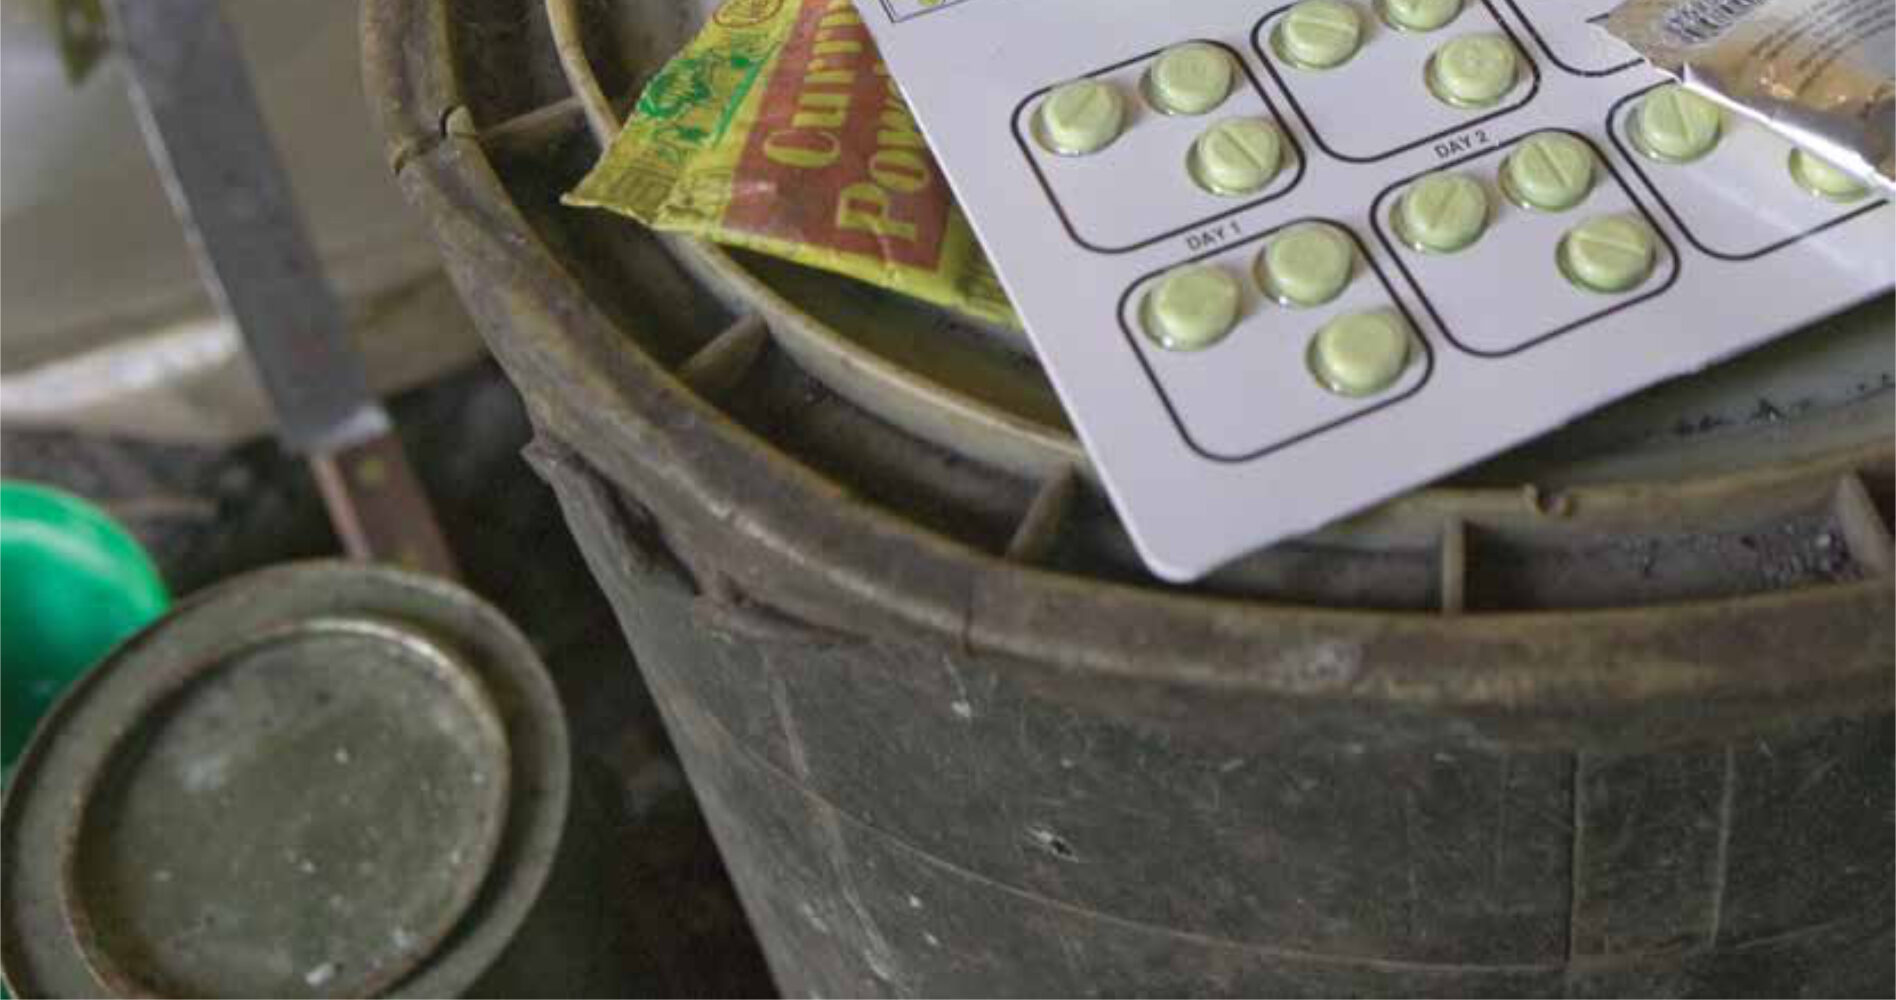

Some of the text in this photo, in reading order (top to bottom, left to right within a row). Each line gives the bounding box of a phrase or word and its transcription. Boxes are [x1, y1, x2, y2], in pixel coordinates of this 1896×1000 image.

[836, 62, 928, 239] Pow
[1434, 129, 1489, 159] DAY 2
[1185, 222, 1242, 251] DAY 1
